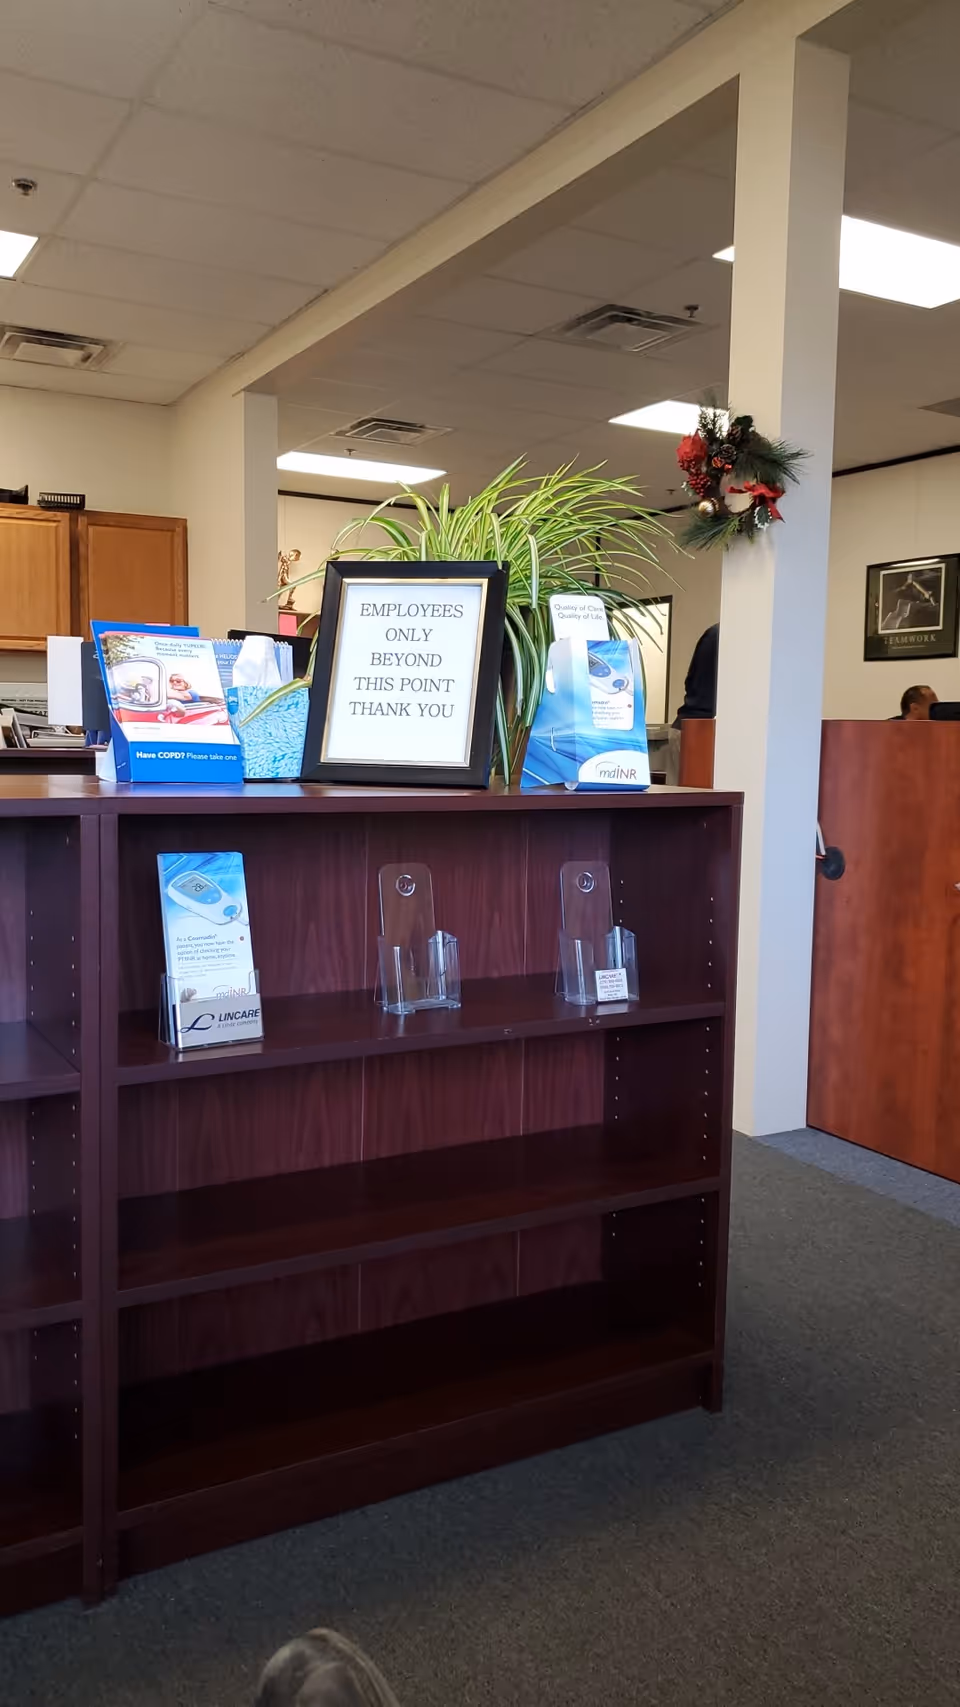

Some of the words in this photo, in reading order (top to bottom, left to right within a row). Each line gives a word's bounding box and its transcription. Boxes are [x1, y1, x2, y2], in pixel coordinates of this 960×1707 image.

[360, 603, 464, 618] EMPLOYEES
[554, 604, 577, 612] Quality
[558, 612, 581, 620] Quality
[385, 627, 433, 641] ONLY
[884, 634, 936, 645] TEAMWORK
[370, 652, 442, 667] BEYOND
[353, 677, 394, 691] THIS
[399, 678, 455, 692] POINT
[349, 702, 412, 717] THANK
[417, 703, 455, 718] YOU
[136, 751, 156, 759] Have
[157, 751, 185, 759] COPD?
[218, 1008, 260, 1022] LINCARE
